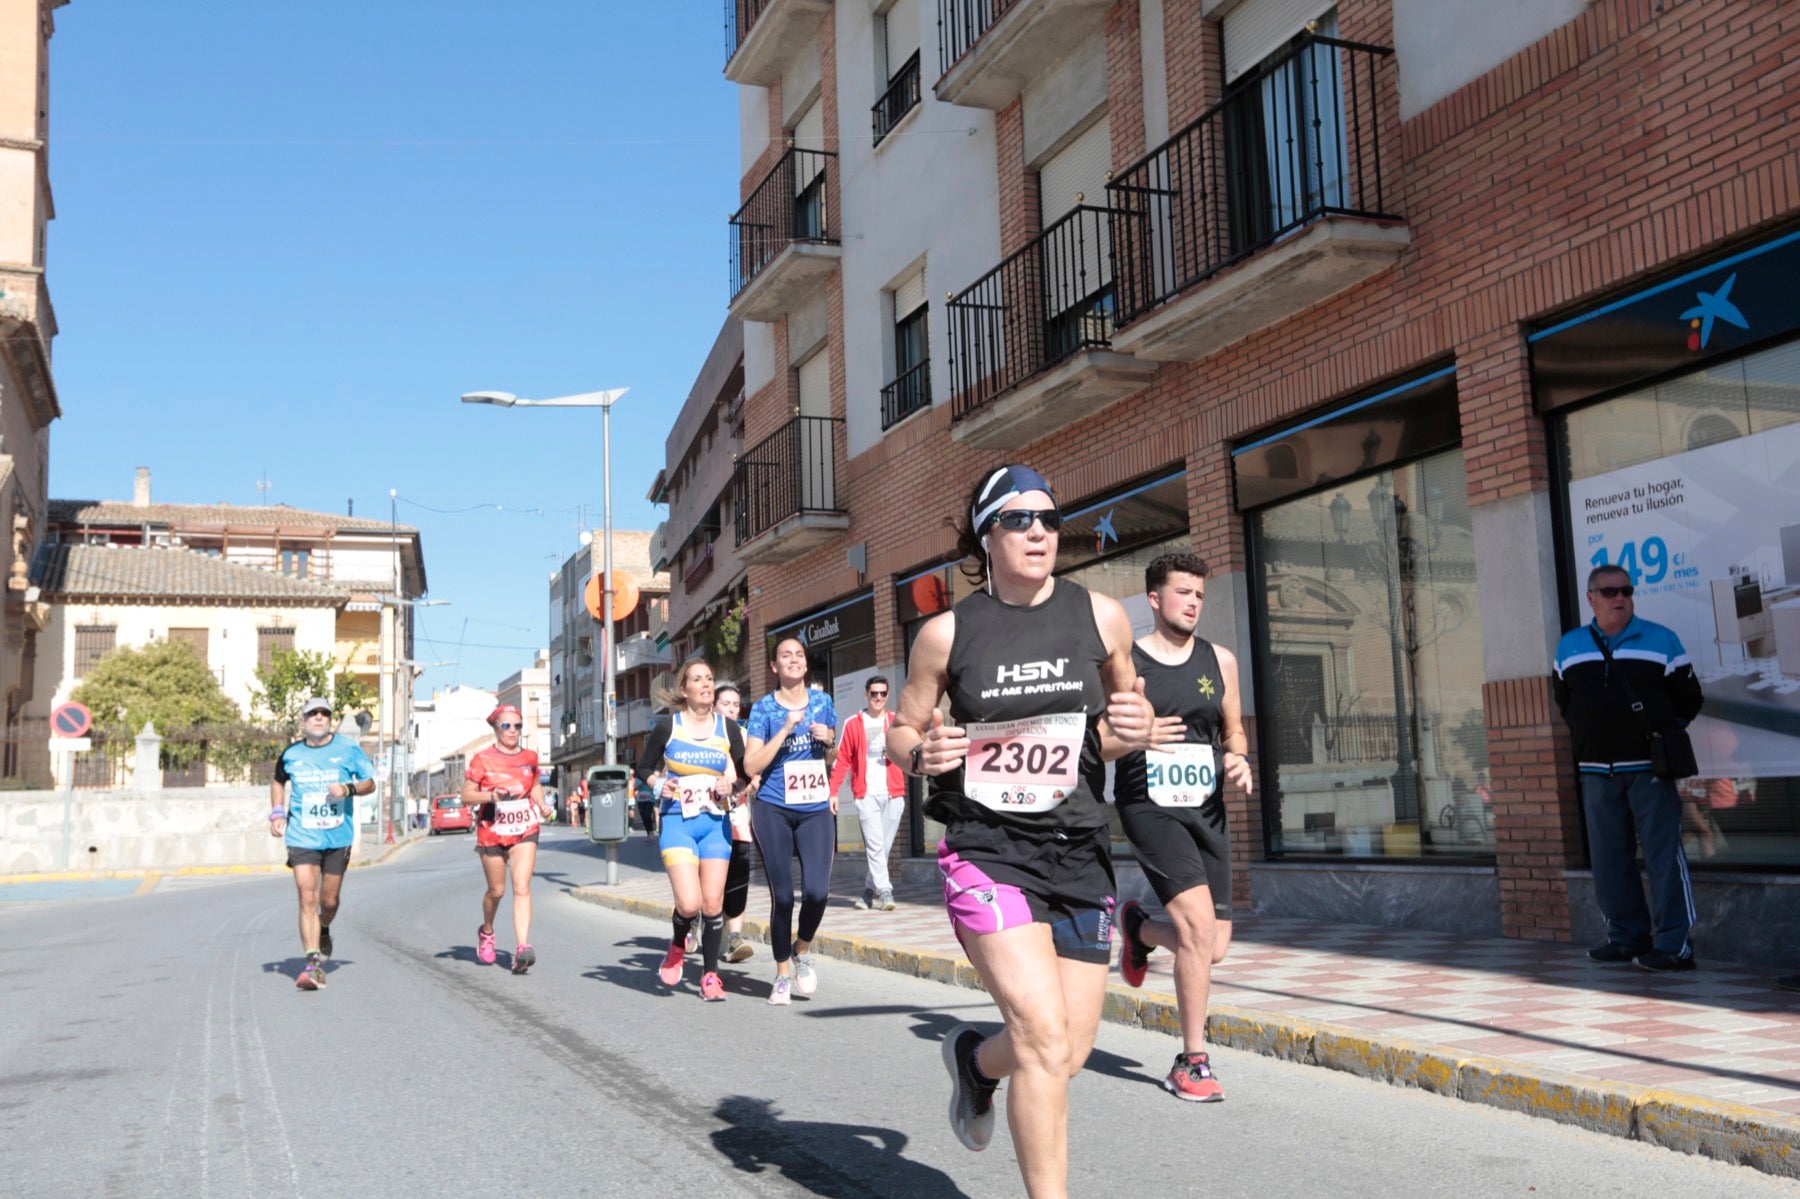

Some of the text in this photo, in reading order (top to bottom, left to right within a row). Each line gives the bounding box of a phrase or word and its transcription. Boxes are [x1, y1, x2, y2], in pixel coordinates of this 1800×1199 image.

[1585, 478, 1684, 510] Renueva tu hogar,
[1586, 493, 1684, 525] renueva tu ilusión
[1588, 533, 1604, 546] por
[1673, 566, 1699, 580] mes
[808, 616, 840, 642] CaixaBank
[996, 658, 1065, 683] HSN
[981, 681, 1083, 699] WE ARE NUTRITION!
[1055, 715, 1078, 726] FONDO
[981, 742, 1070, 775] 2302
[788, 774, 826, 790] 2124
[1153, 764, 1212, 786] 1060
[309, 804, 338, 817] 465
[498, 809, 531, 825] 2093
